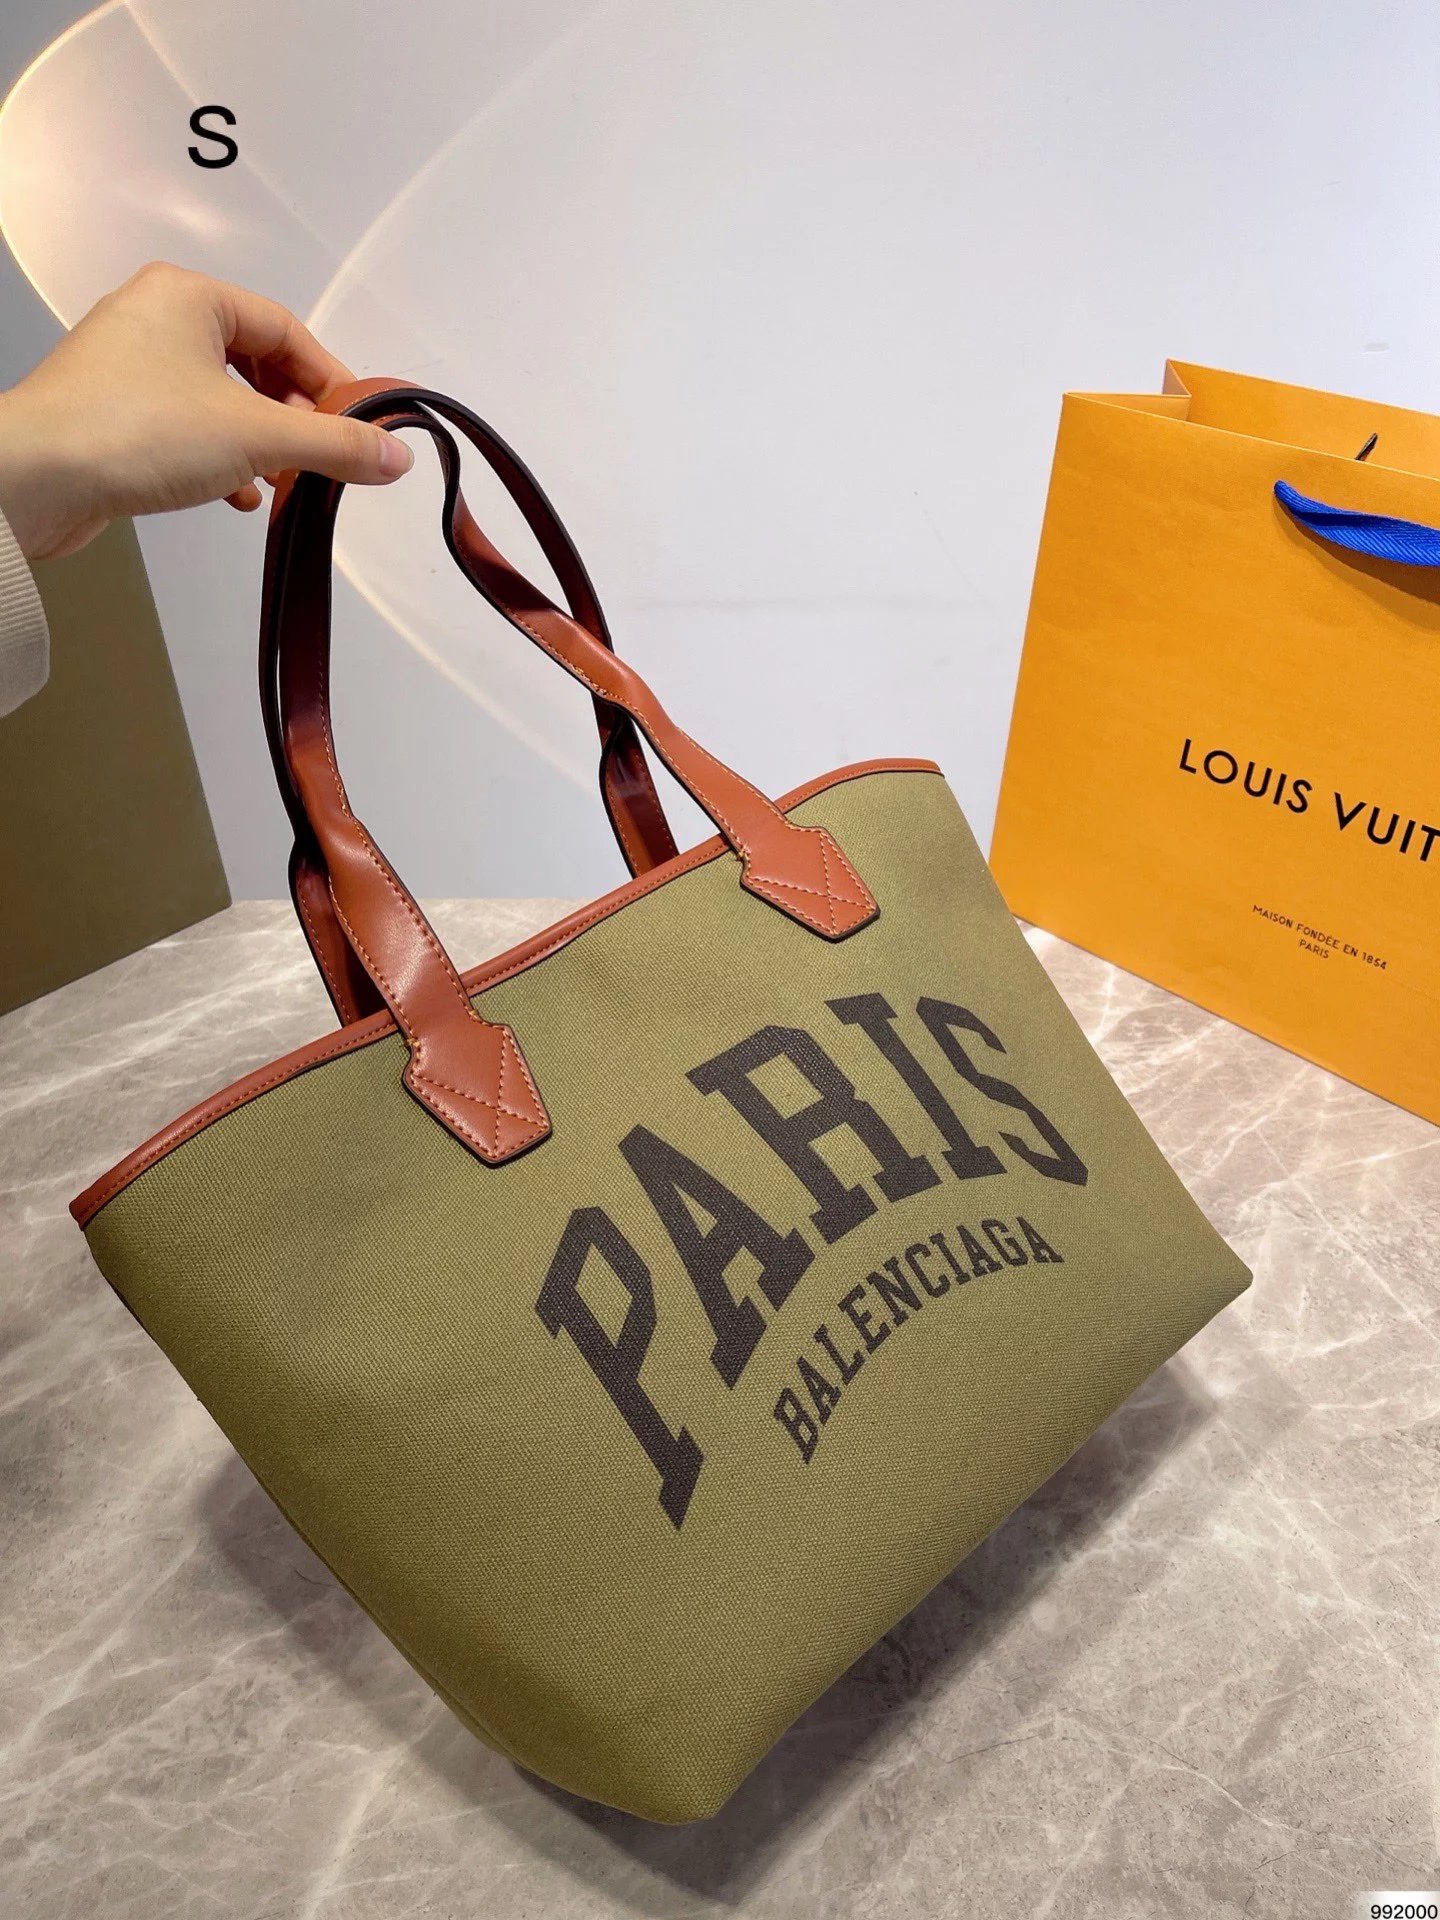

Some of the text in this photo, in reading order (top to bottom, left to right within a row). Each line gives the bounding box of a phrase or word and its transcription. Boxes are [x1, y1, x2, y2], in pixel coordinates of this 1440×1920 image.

[1179, 738, 1440, 862] LOUIS VUIT
[1252, 904, 1388, 970] MAISON FONDÉE EN 1854
[1299, 938, 1330, 959] PARIS
[534, 992, 1089, 1531] PARIS
[773, 1216, 1065, 1465] BALENCIAGA
